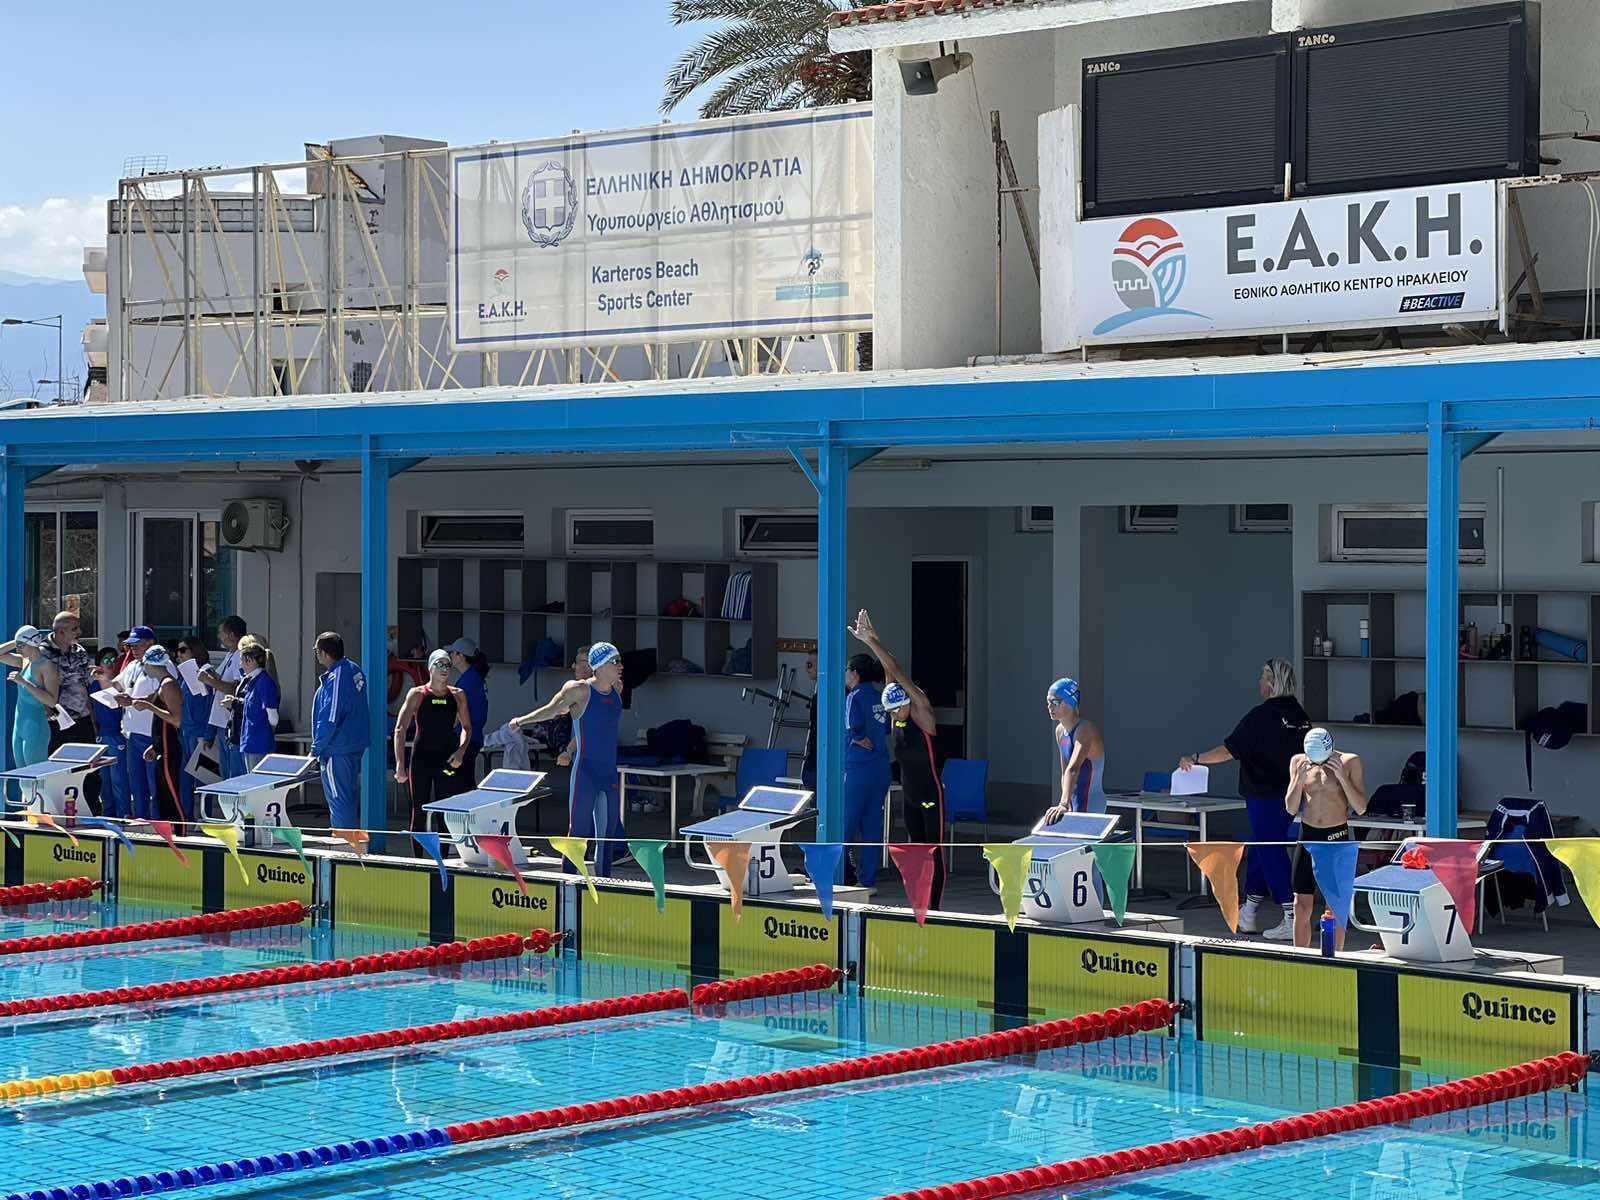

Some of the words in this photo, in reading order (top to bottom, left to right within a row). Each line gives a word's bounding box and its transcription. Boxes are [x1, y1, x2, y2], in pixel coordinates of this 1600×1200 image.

[586, 169, 673, 196] ΕΛΛΗΝΙΚΗ
[679, 156, 802, 187] ΔΗΜΟΚΡΑΤΙΑ
[587, 204, 686, 235] Υφυπουργείο
[690, 195, 785, 225] Αθλητισμού
[1225, 192, 1483, 275] Ε.Α.Κ.Η.
[592, 265, 652, 284] Karteros
[655, 258, 699, 279] Beach
[1234, 285, 1278, 300] ΕΘΝΙΚΟ
[1280, 280, 1341, 296] ΑΘΛΗΤΙΚΟ
[1344, 276, 1394, 291] ΚΕΝΤΡΟ
[1397, 270, 1469, 287] ΗΡΑΚΛΕΙΟΥ
[598, 292, 643, 315] Sports
[646, 289, 693, 308] Center
[1402, 295, 1462, 310] #BEACTIVE
[53, 843, 97, 864] Quince
[759, 845, 776, 879] 5
[257, 863, 306, 885] Quince
[1072, 870, 1089, 908] 6
[491, 887, 548, 910] Quince
[764, 916, 829, 941] Quince
[1388, 910, 1411, 945] 7
[1443, 904, 1457, 945] 7
[1081, 947, 1158, 978] Quince
[1462, 991, 1557, 1026] Quince
